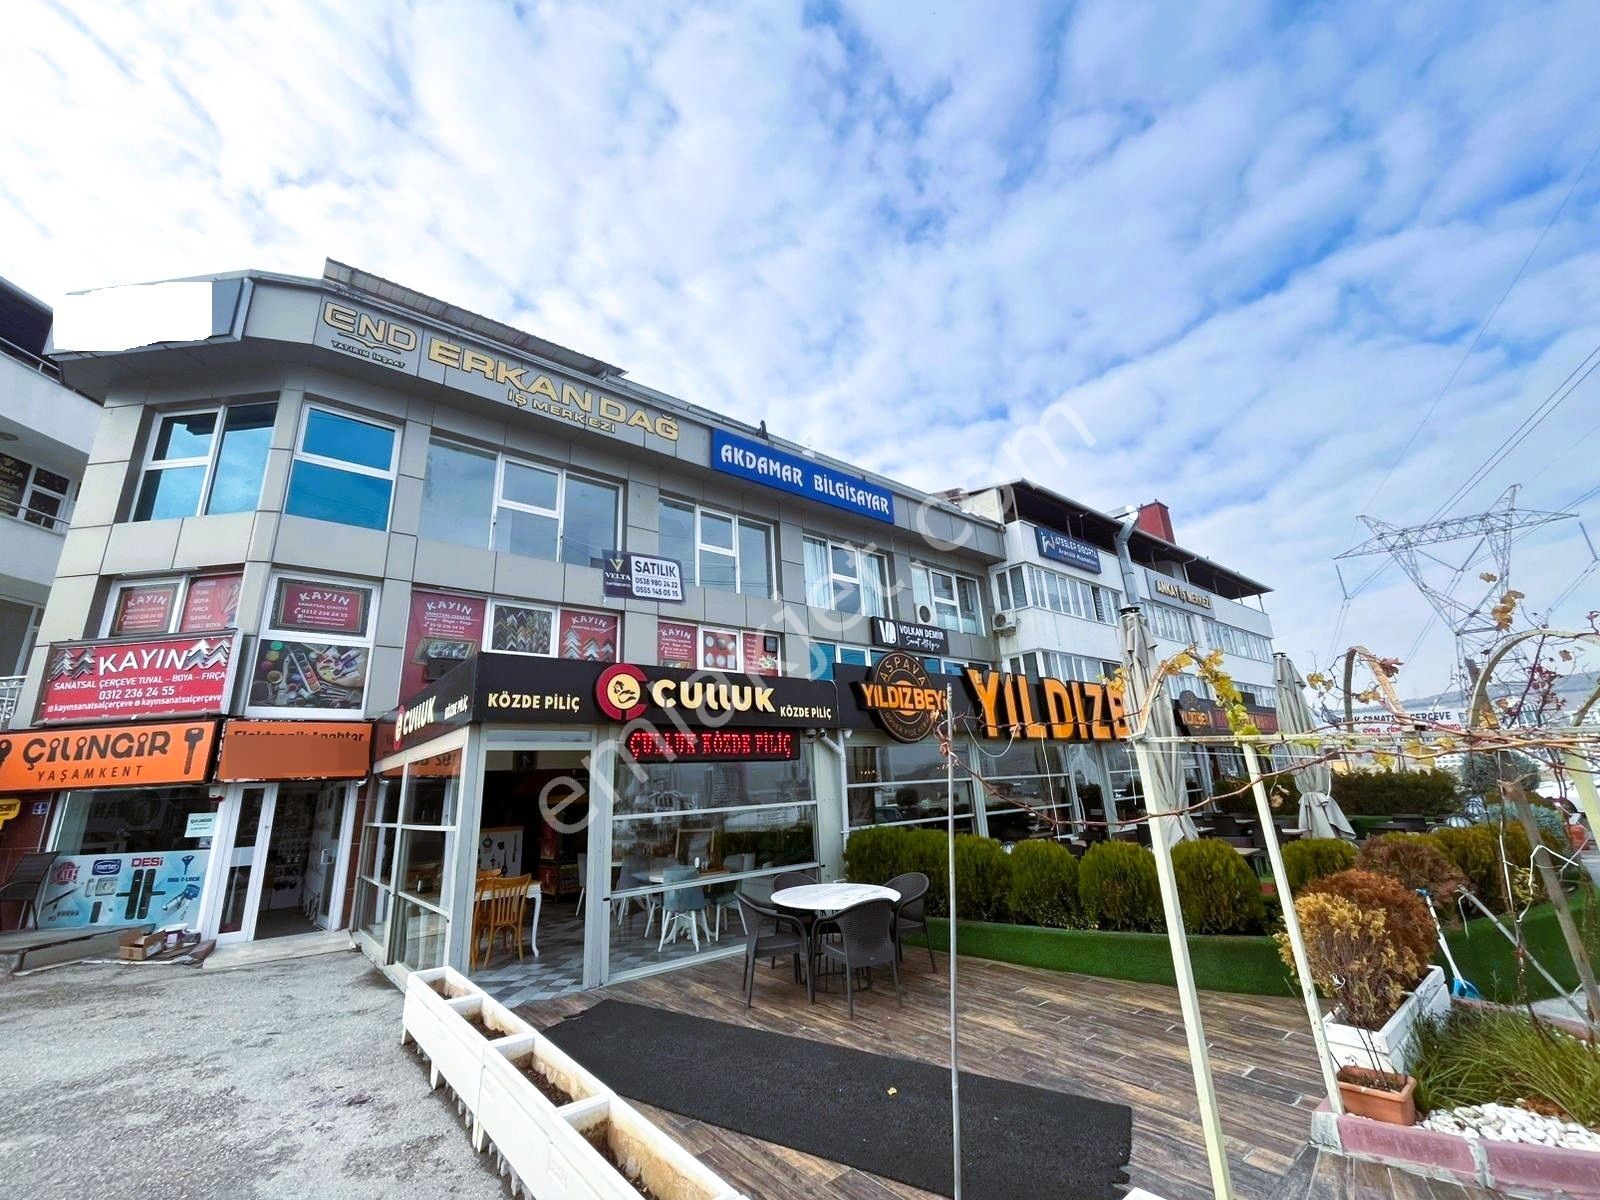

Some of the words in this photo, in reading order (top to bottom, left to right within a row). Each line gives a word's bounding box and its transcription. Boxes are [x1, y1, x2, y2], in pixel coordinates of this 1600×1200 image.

[532, 398, 617, 434] MERKEZİ
[720, 444, 804, 488] AKDAMAR
[812, 472, 890, 516] BİLGİSAYAR
[604, 571, 632, 582] VELTA
[634, 560, 677, 578] SATILIK
[651, 578, 663, 586] 980
[299, 591, 350, 606] KAYIN
[635, 586, 651, 594] 0555
[652, 588, 662, 596] 145
[127, 594, 167, 608] KAYIN
[426, 601, 473, 615] KAYIN
[571, 615, 608, 628] KAYIN
[661, 628, 692, 640] KAYIN
[899, 624, 924, 637] VOLKAN
[99, 648, 189, 677] KAYIN
[881, 656, 927, 686] ASPAVA
[53, 681, 97, 691] SANATSAL
[98, 677, 138, 689] ÇERÇEVE
[138, 674, 164, 685] TUVAL
[171, 673, 193, 683] BOYA
[201, 670, 226, 682] FIRÇA
[98, 689, 122, 701] 0312
[124, 687, 144, 698] 236
[145, 686, 158, 697] 24
[161, 685, 175, 696] 55
[487, 690, 540, 709] KÖZDE
[544, 693, 580, 713] PİLİÇ
[779, 704, 809, 718] KÖZDE
[811, 706, 832, 720] PİLİÇ
[22, 730, 172, 770] ÇİLİNGİR
[629, 731, 697, 760] ÇULLUK
[701, 730, 751, 755] KÖZDE
[754, 731, 792, 758] PİLİÇ
[37, 764, 145, 783] YAŞAMKENT
